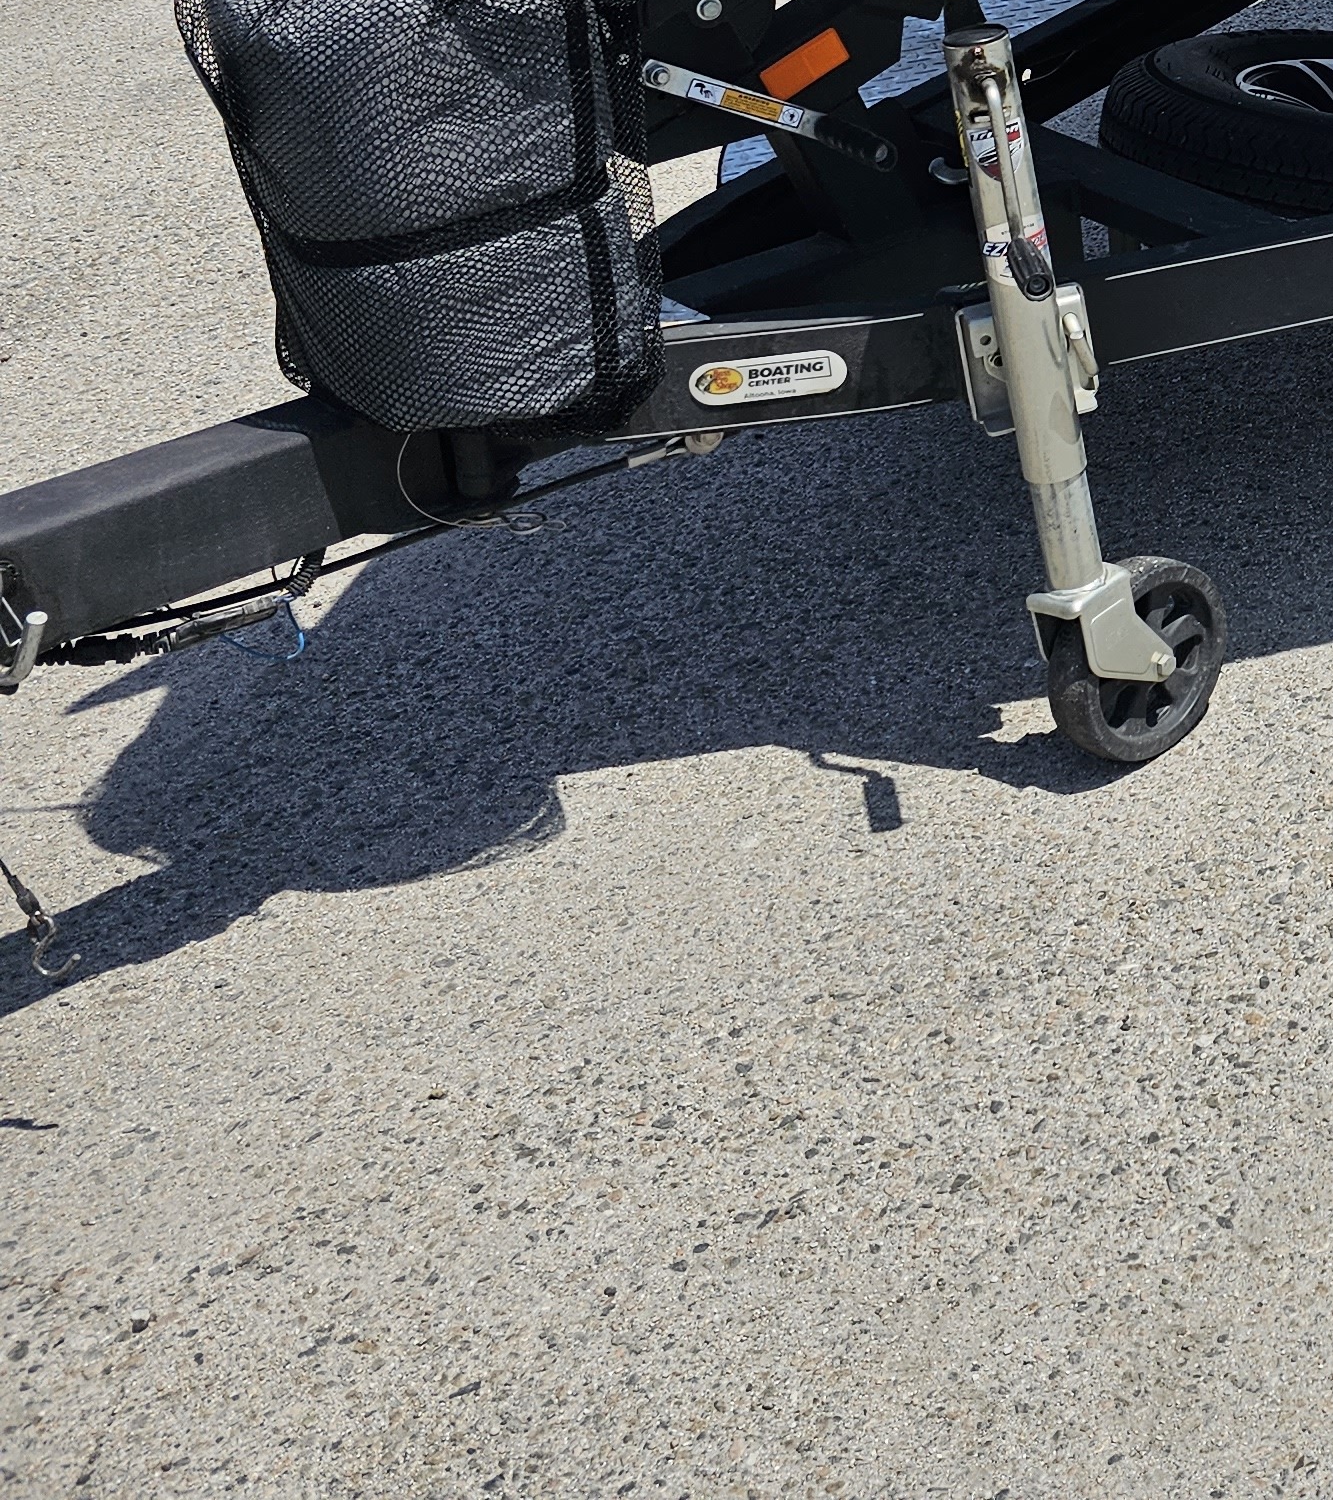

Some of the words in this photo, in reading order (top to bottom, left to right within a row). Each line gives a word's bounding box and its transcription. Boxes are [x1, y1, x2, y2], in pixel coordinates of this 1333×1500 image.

[748, 361, 825, 379] BOATING
[747, 376, 791, 388] CENTER
[743, 390, 775, 400] Altoona,
[777, 388, 797, 396] Iowa
